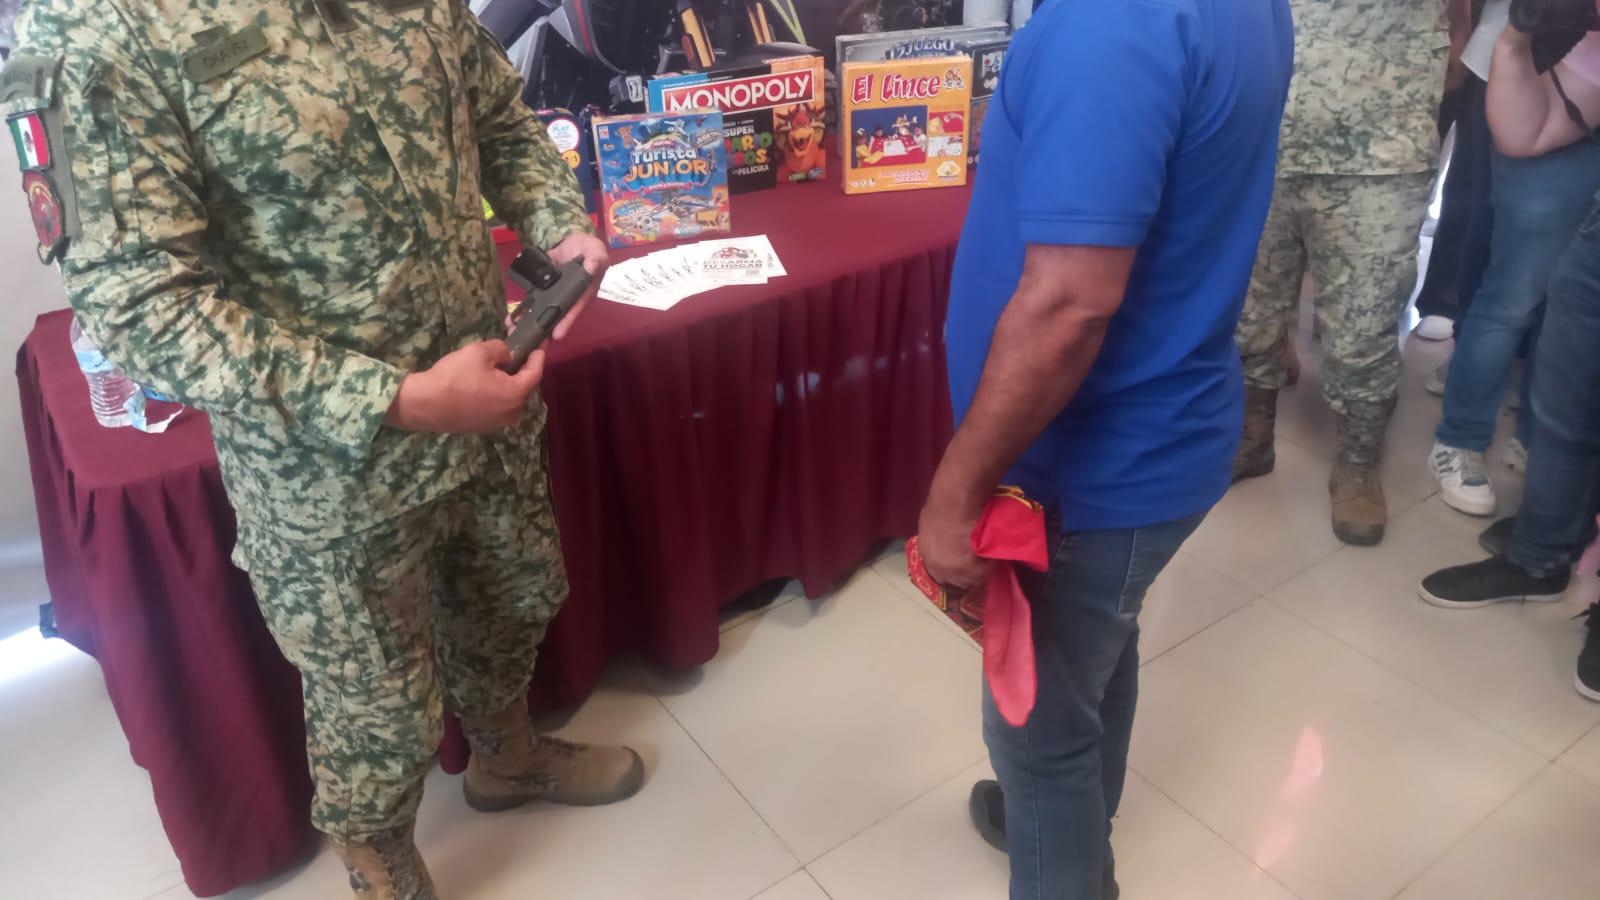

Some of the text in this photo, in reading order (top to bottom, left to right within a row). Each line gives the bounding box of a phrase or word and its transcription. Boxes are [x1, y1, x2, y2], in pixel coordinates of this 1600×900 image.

[670, 73, 810, 111] MONOPOLY
[852, 73, 941, 103] El Lince
[723, 125, 755, 138] SUPER
[633, 147, 697, 165] Turista
